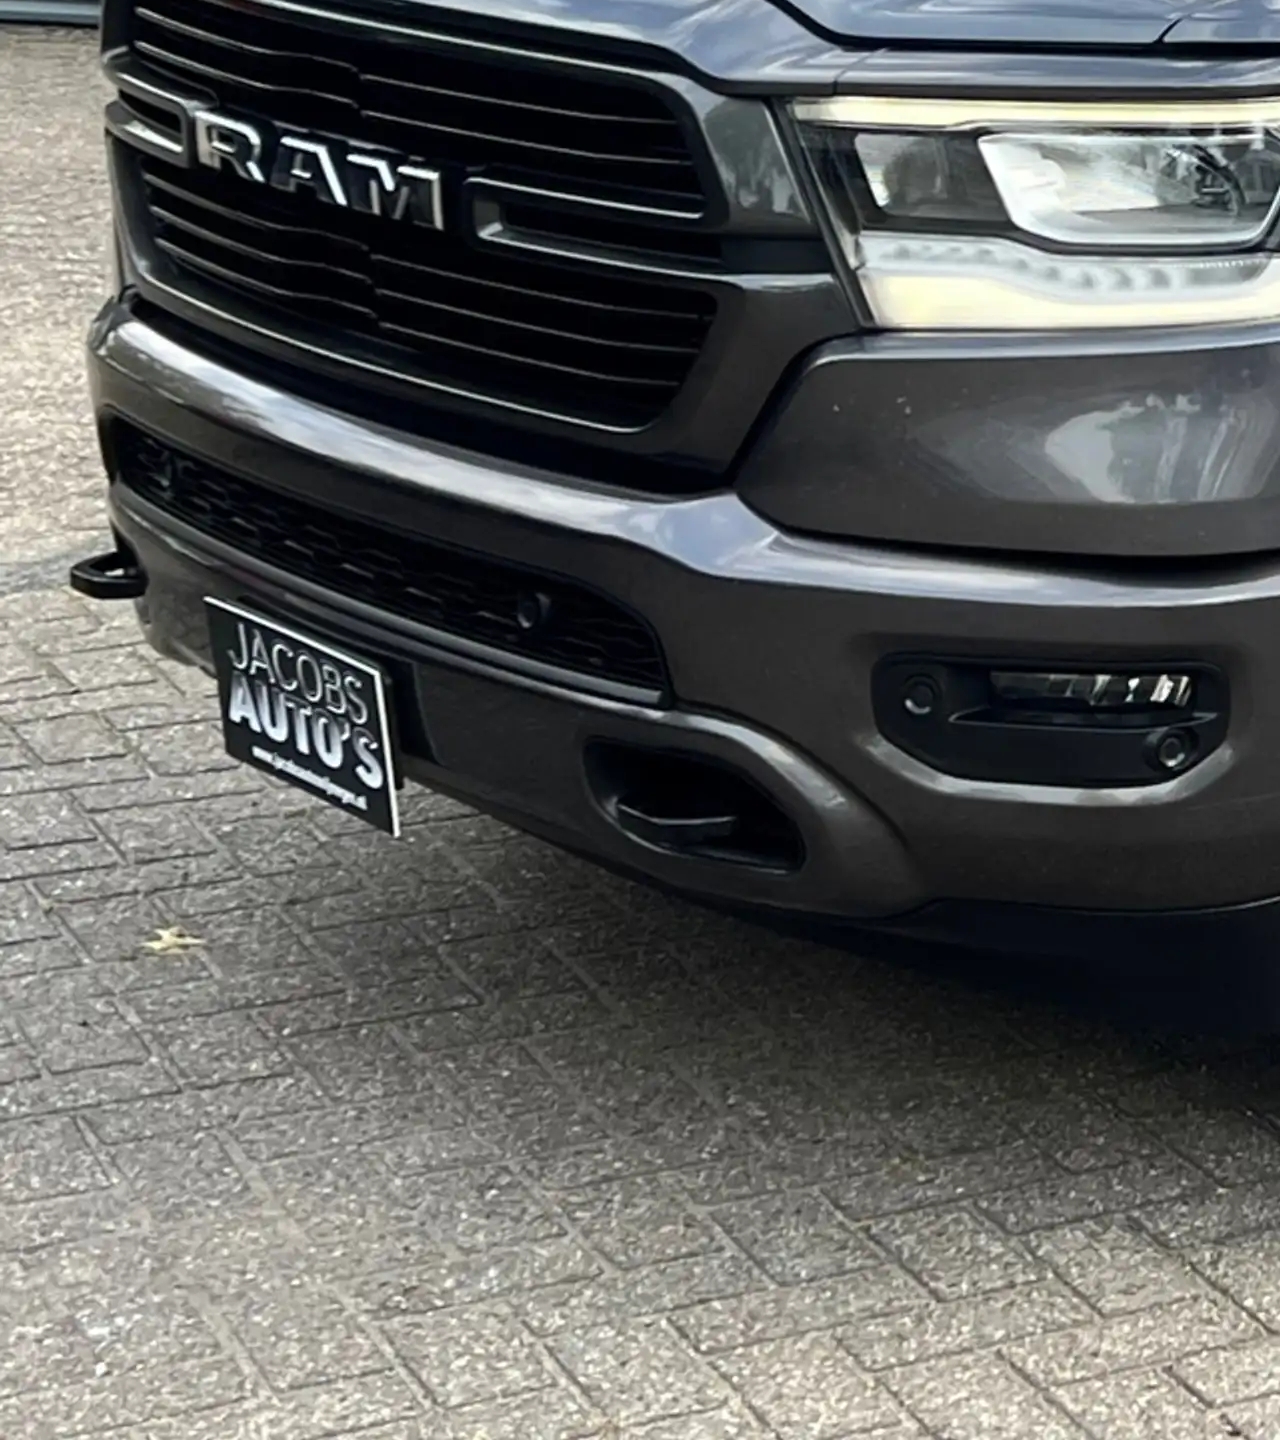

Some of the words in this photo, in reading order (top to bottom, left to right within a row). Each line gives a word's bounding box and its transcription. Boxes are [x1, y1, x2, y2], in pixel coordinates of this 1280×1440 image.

[194, 110, 444, 232] RAM
[226, 622, 369, 725] JACOBS
[228, 671, 384, 790] AUTO'S
